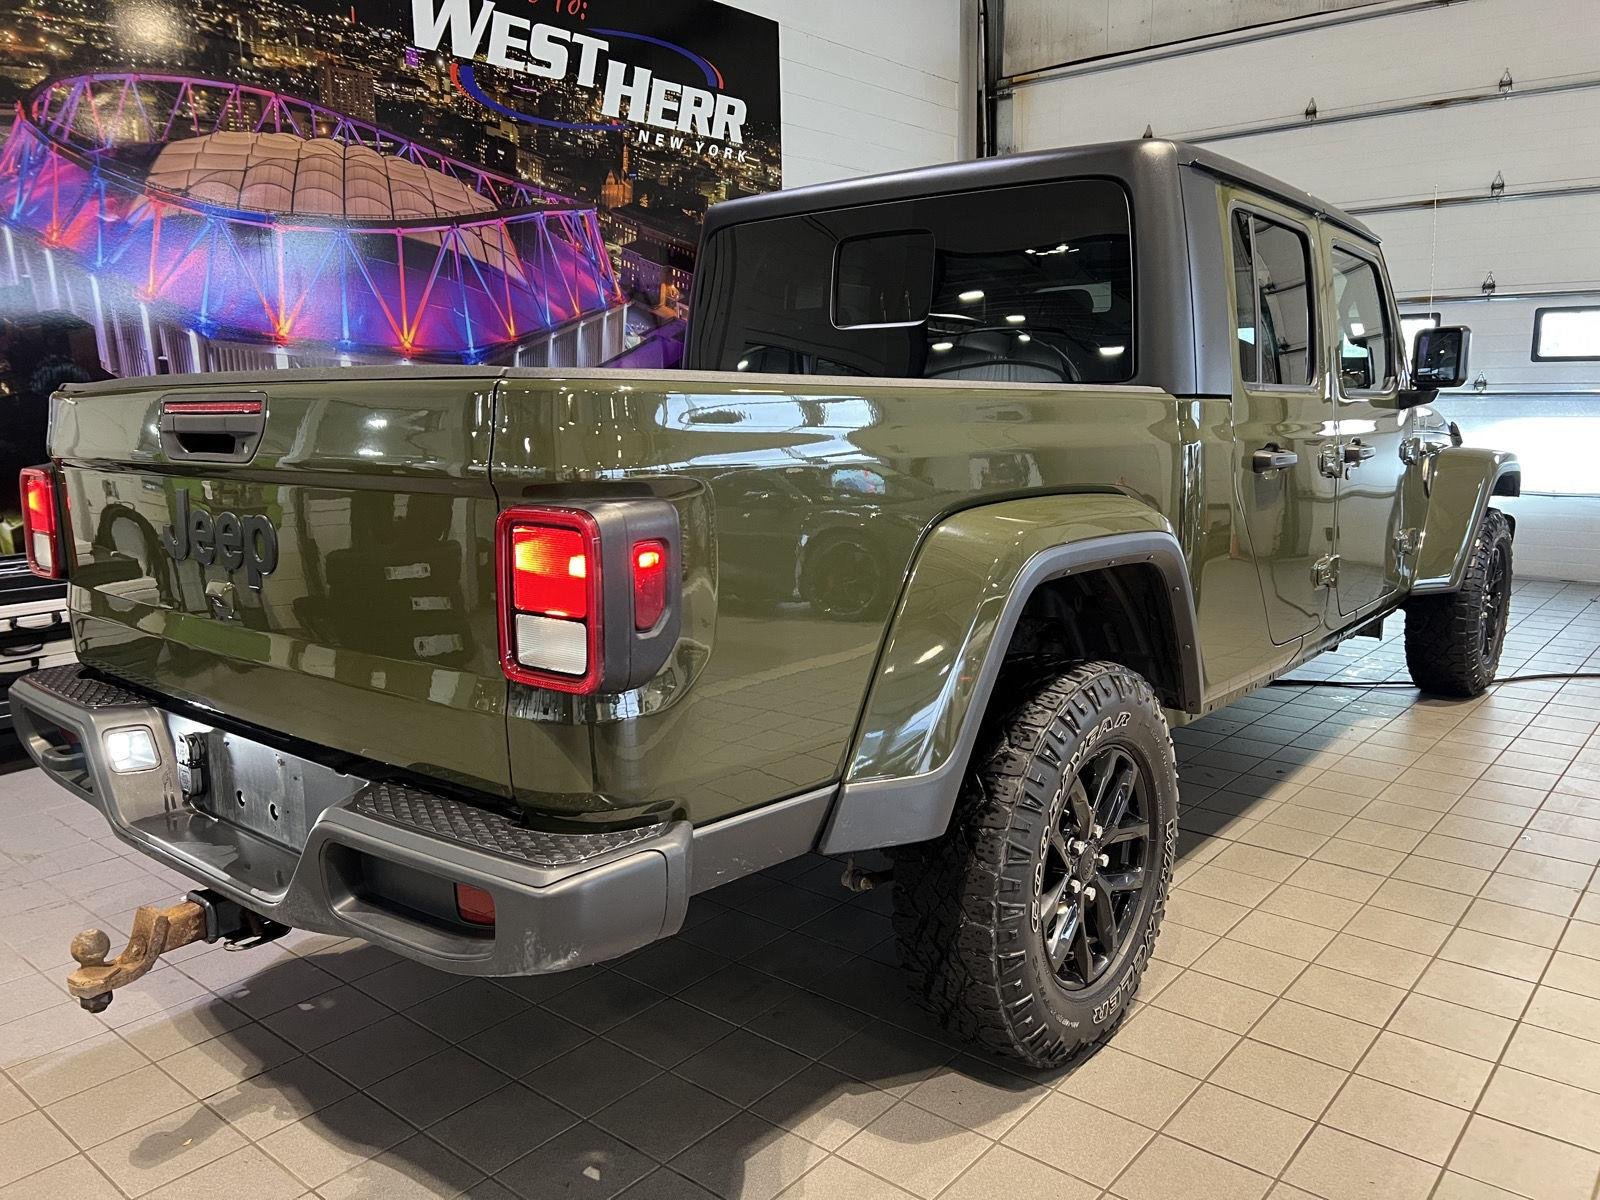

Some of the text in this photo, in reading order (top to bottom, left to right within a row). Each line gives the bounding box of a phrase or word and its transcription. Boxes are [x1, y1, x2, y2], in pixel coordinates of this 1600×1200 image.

[411, 0, 747, 144] WEST HERR
[638, 129, 748, 164] NEW YORK
[163, 488, 279, 592] Jeep
[1031, 711, 1132, 933] GOODYEAR
[1092, 819, 1176, 1025] WRANGLER
